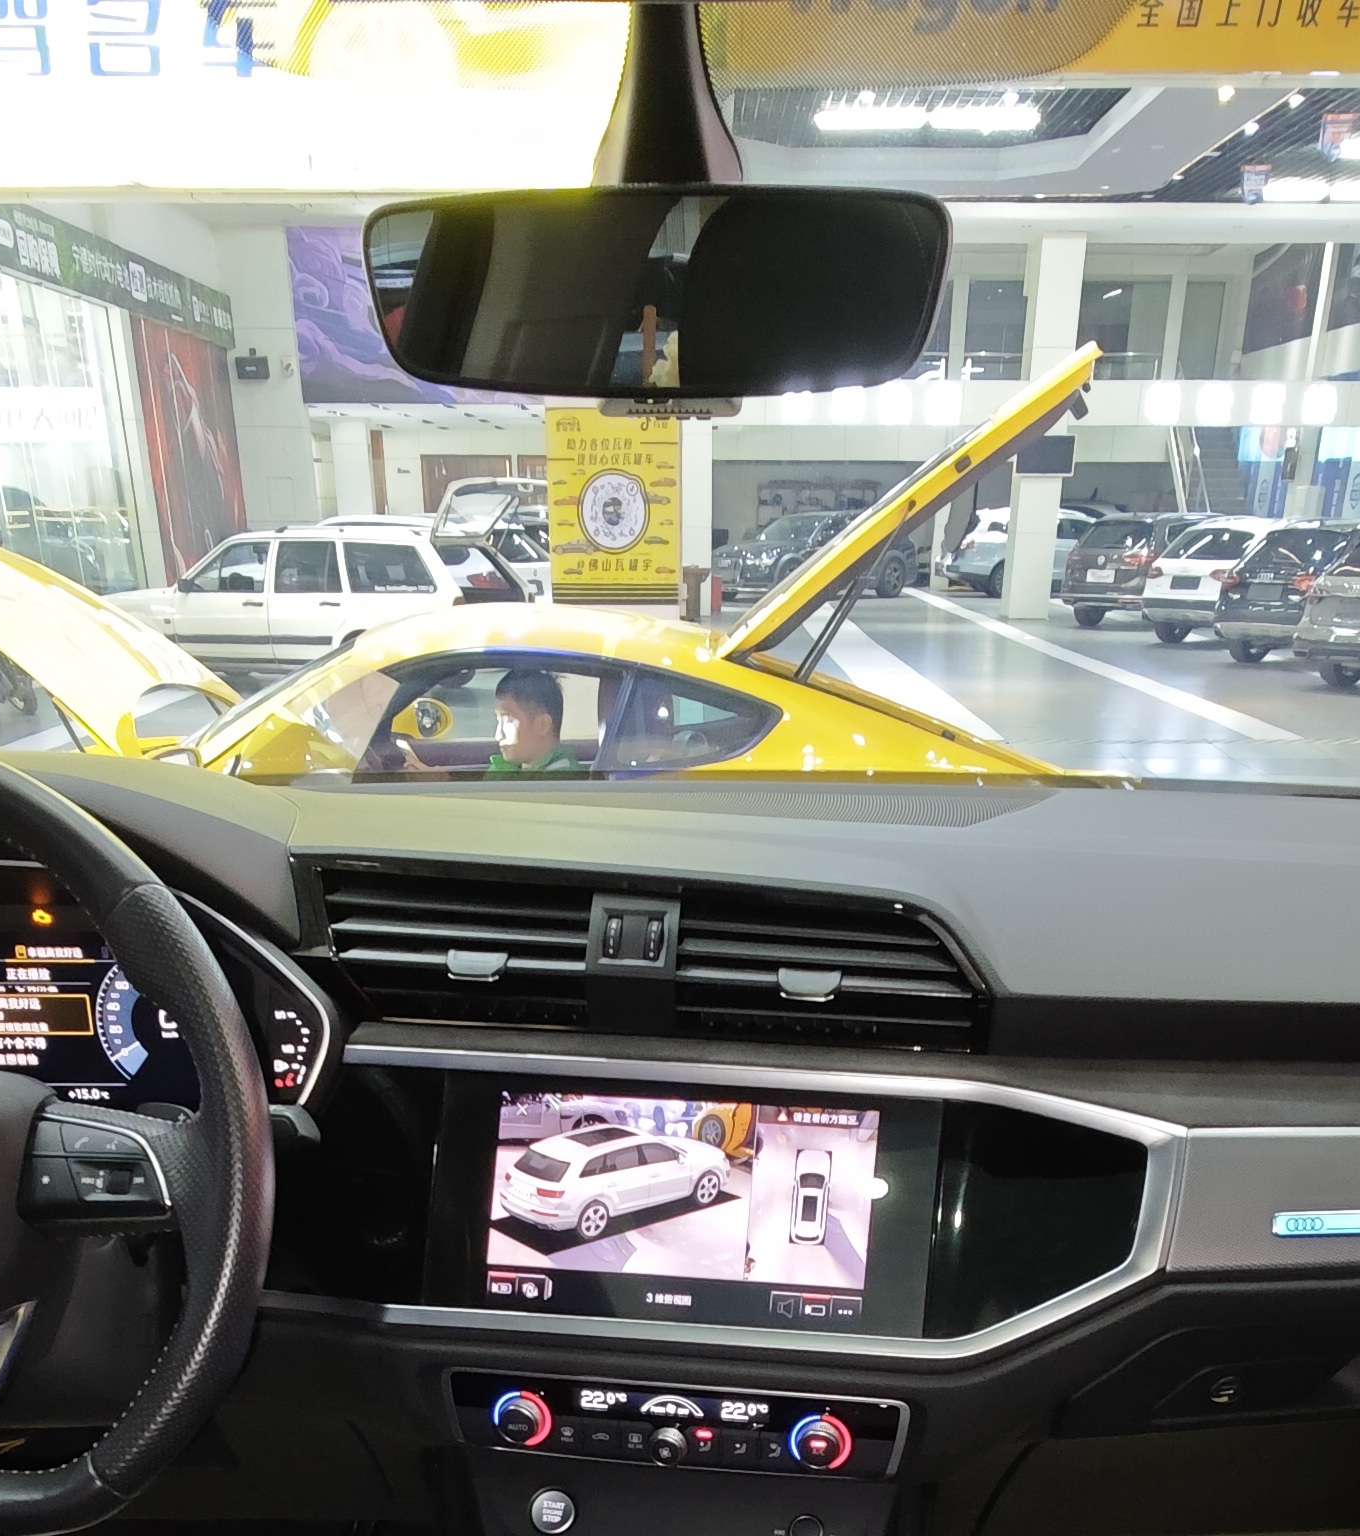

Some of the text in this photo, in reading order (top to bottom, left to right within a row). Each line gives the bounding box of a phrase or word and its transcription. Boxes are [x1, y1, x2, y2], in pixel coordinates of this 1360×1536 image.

[507, 1423, 529, 1432] AUTO
[543, 1500, 565, 1510] START
[542, 1514, 561, 1523] STOP
